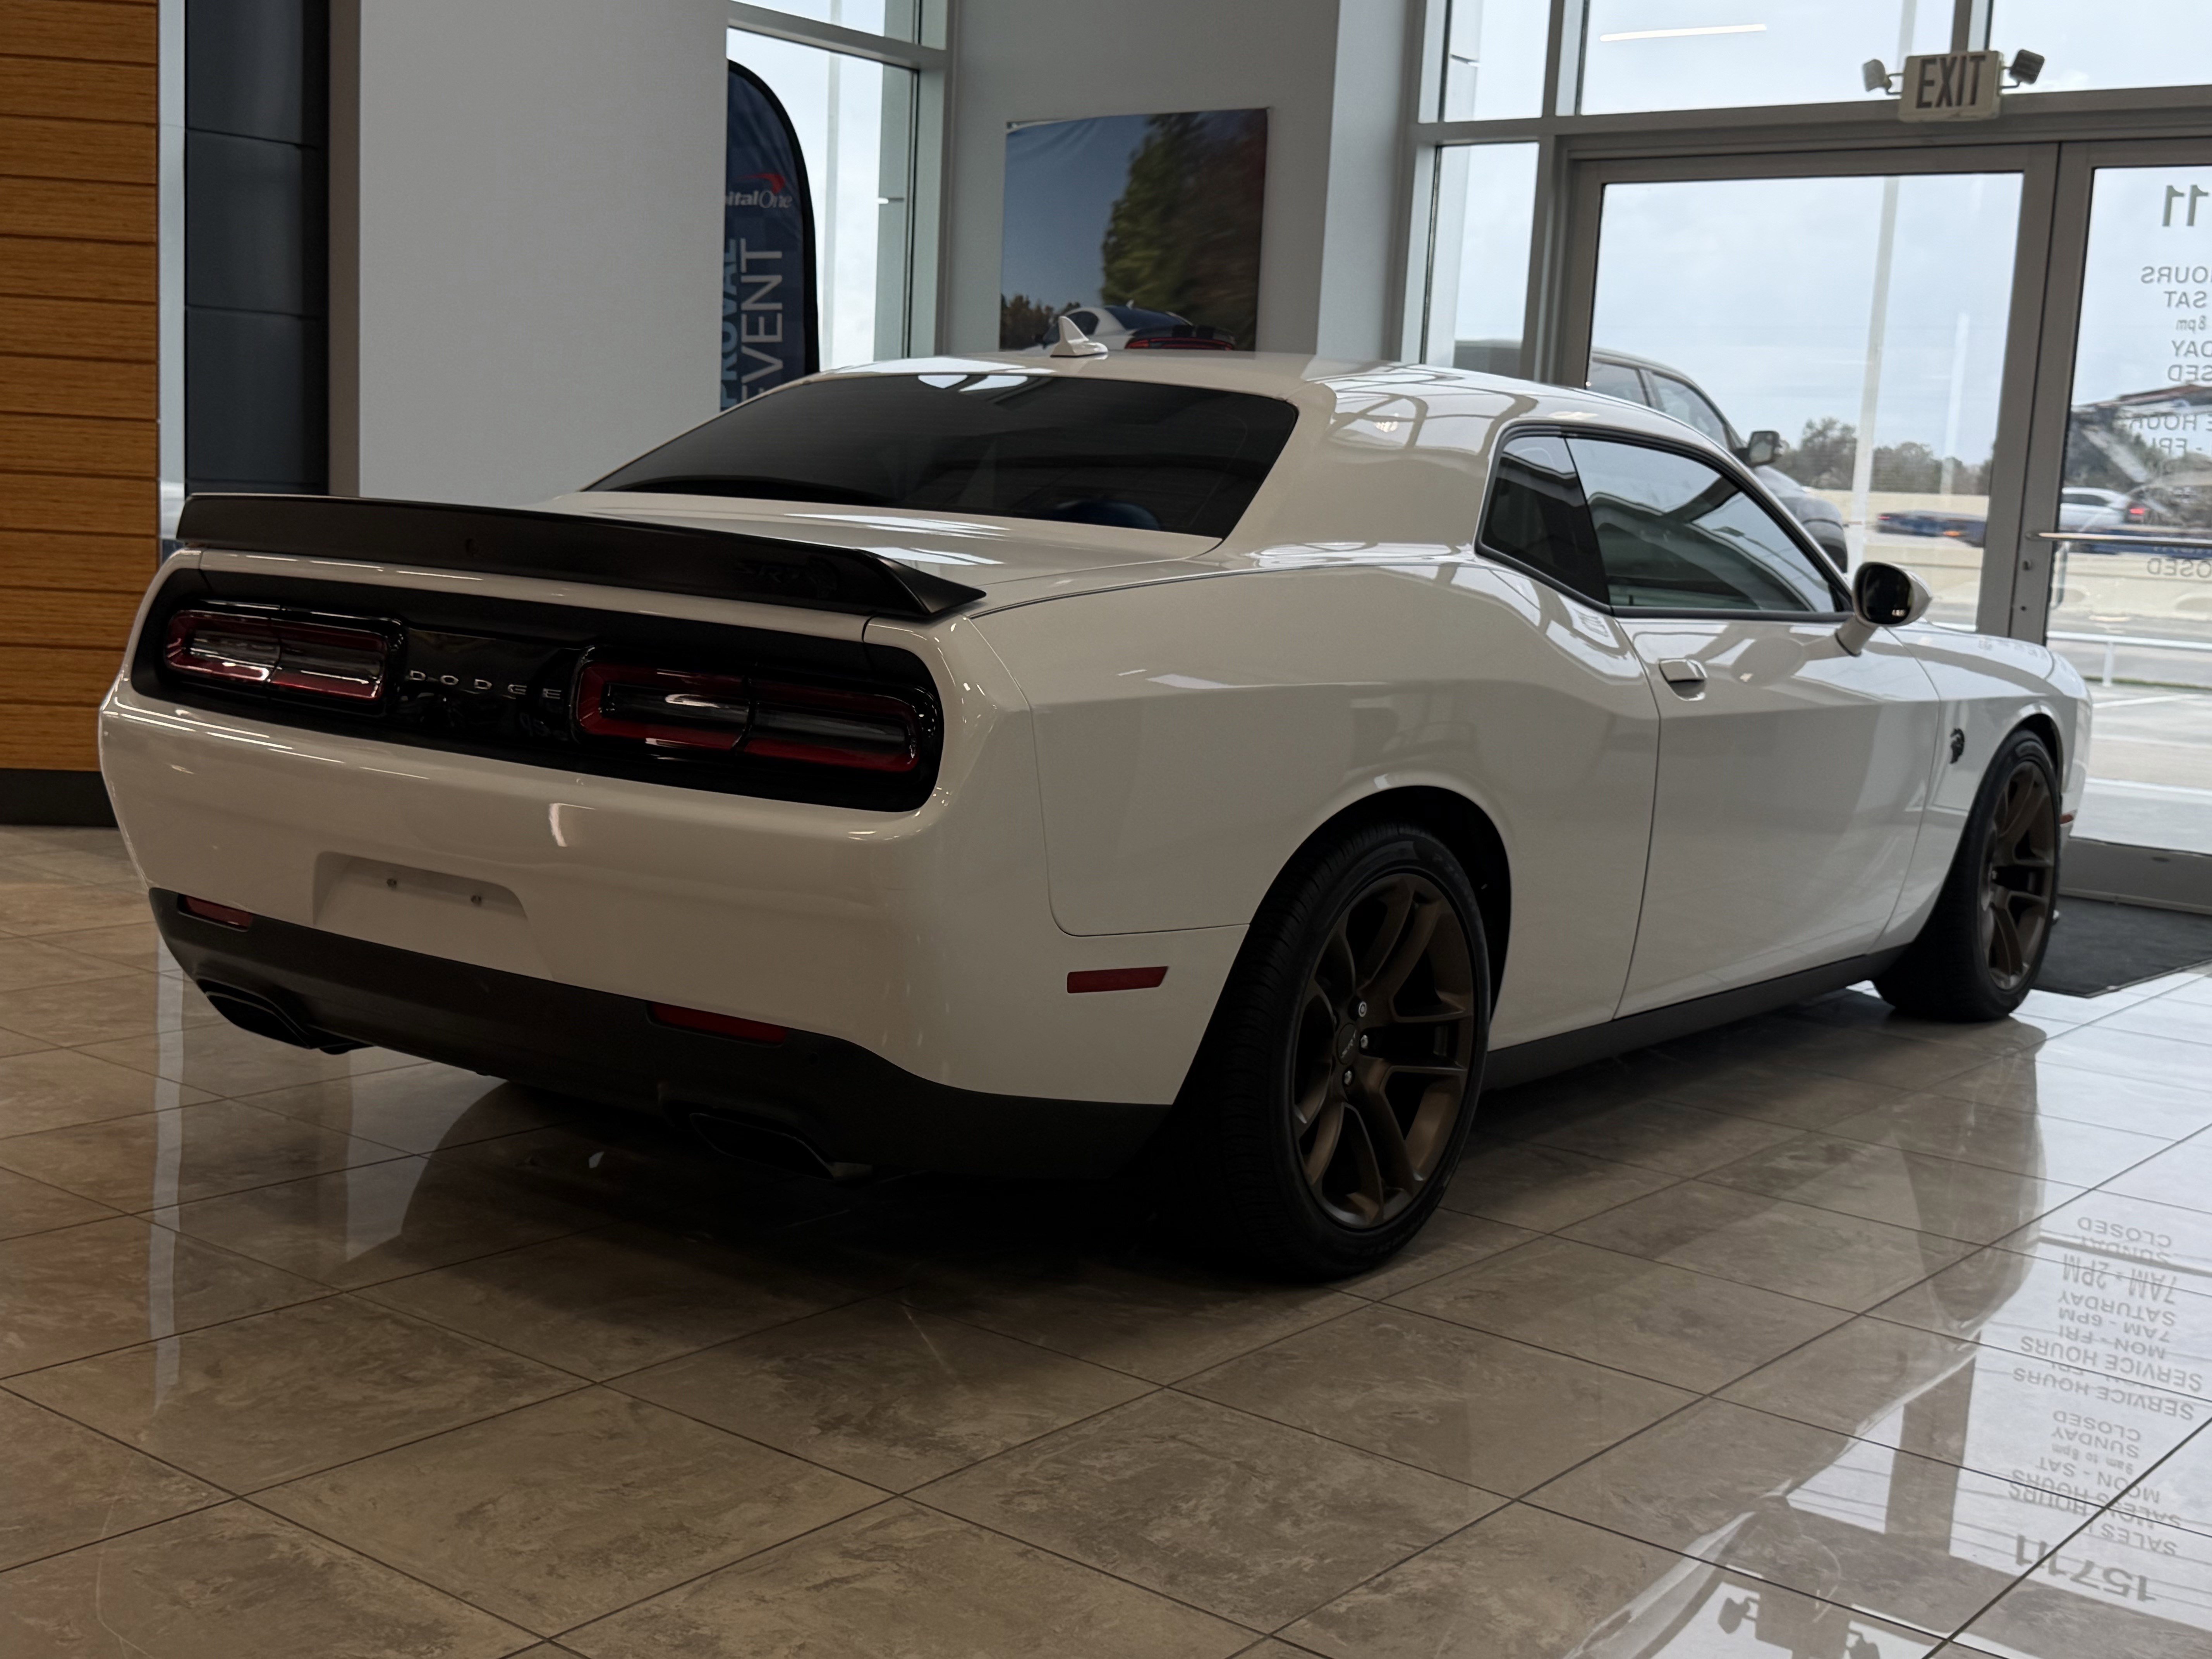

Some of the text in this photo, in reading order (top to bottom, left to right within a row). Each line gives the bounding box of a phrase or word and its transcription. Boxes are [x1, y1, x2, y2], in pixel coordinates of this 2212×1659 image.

[1915, 55, 1986, 109] EXIT
[726, 189, 793, 208] italOne
[409, 670, 562, 699] DODGE
[2077, 1216, 2172, 1248] CLOSED
[2057, 1291, 2176, 1327] SATURDAY
[2059, 1307, 2102, 1327] 6PM
[2059, 1325, 2098, 1345] FRI
[2124, 1323, 2172, 1343] 7AM
[2020, 1336, 2097, 1367] HOURS
[2114, 1338, 2165, 1360] MON
[2013, 1367, 2089, 1395] HOURS
[2105, 1353, 2203, 1392] SERVICE
[2096, 1386, 2194, 1421] SERVICE
[2052, 1410, 2141, 1442] CLOSED
[2051, 1426, 2140, 1459] SUNDAY
[2037, 1456, 2076, 1478] SAT
